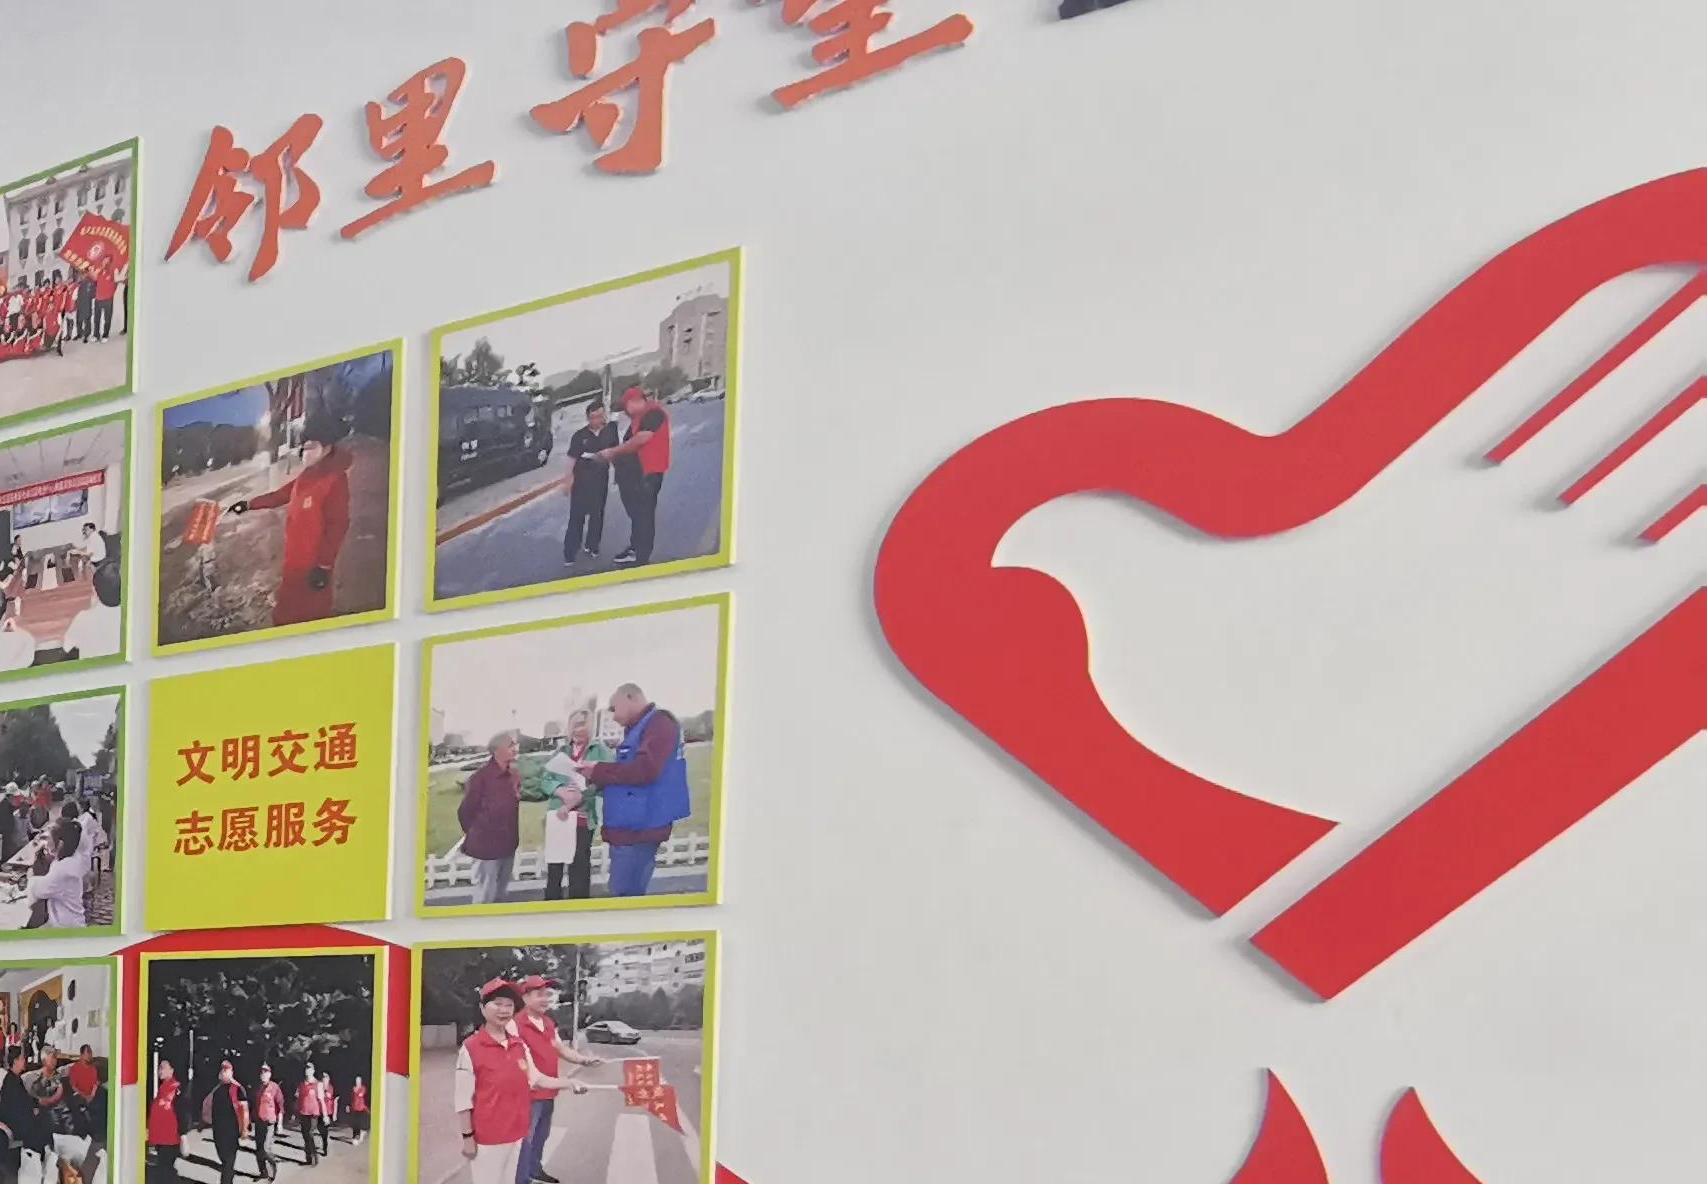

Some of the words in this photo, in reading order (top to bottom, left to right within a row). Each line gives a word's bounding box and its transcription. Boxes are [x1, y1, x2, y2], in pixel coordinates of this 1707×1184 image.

[176, 722, 359, 787] 文明交通
[173, 797, 358, 857] 志愿服务
